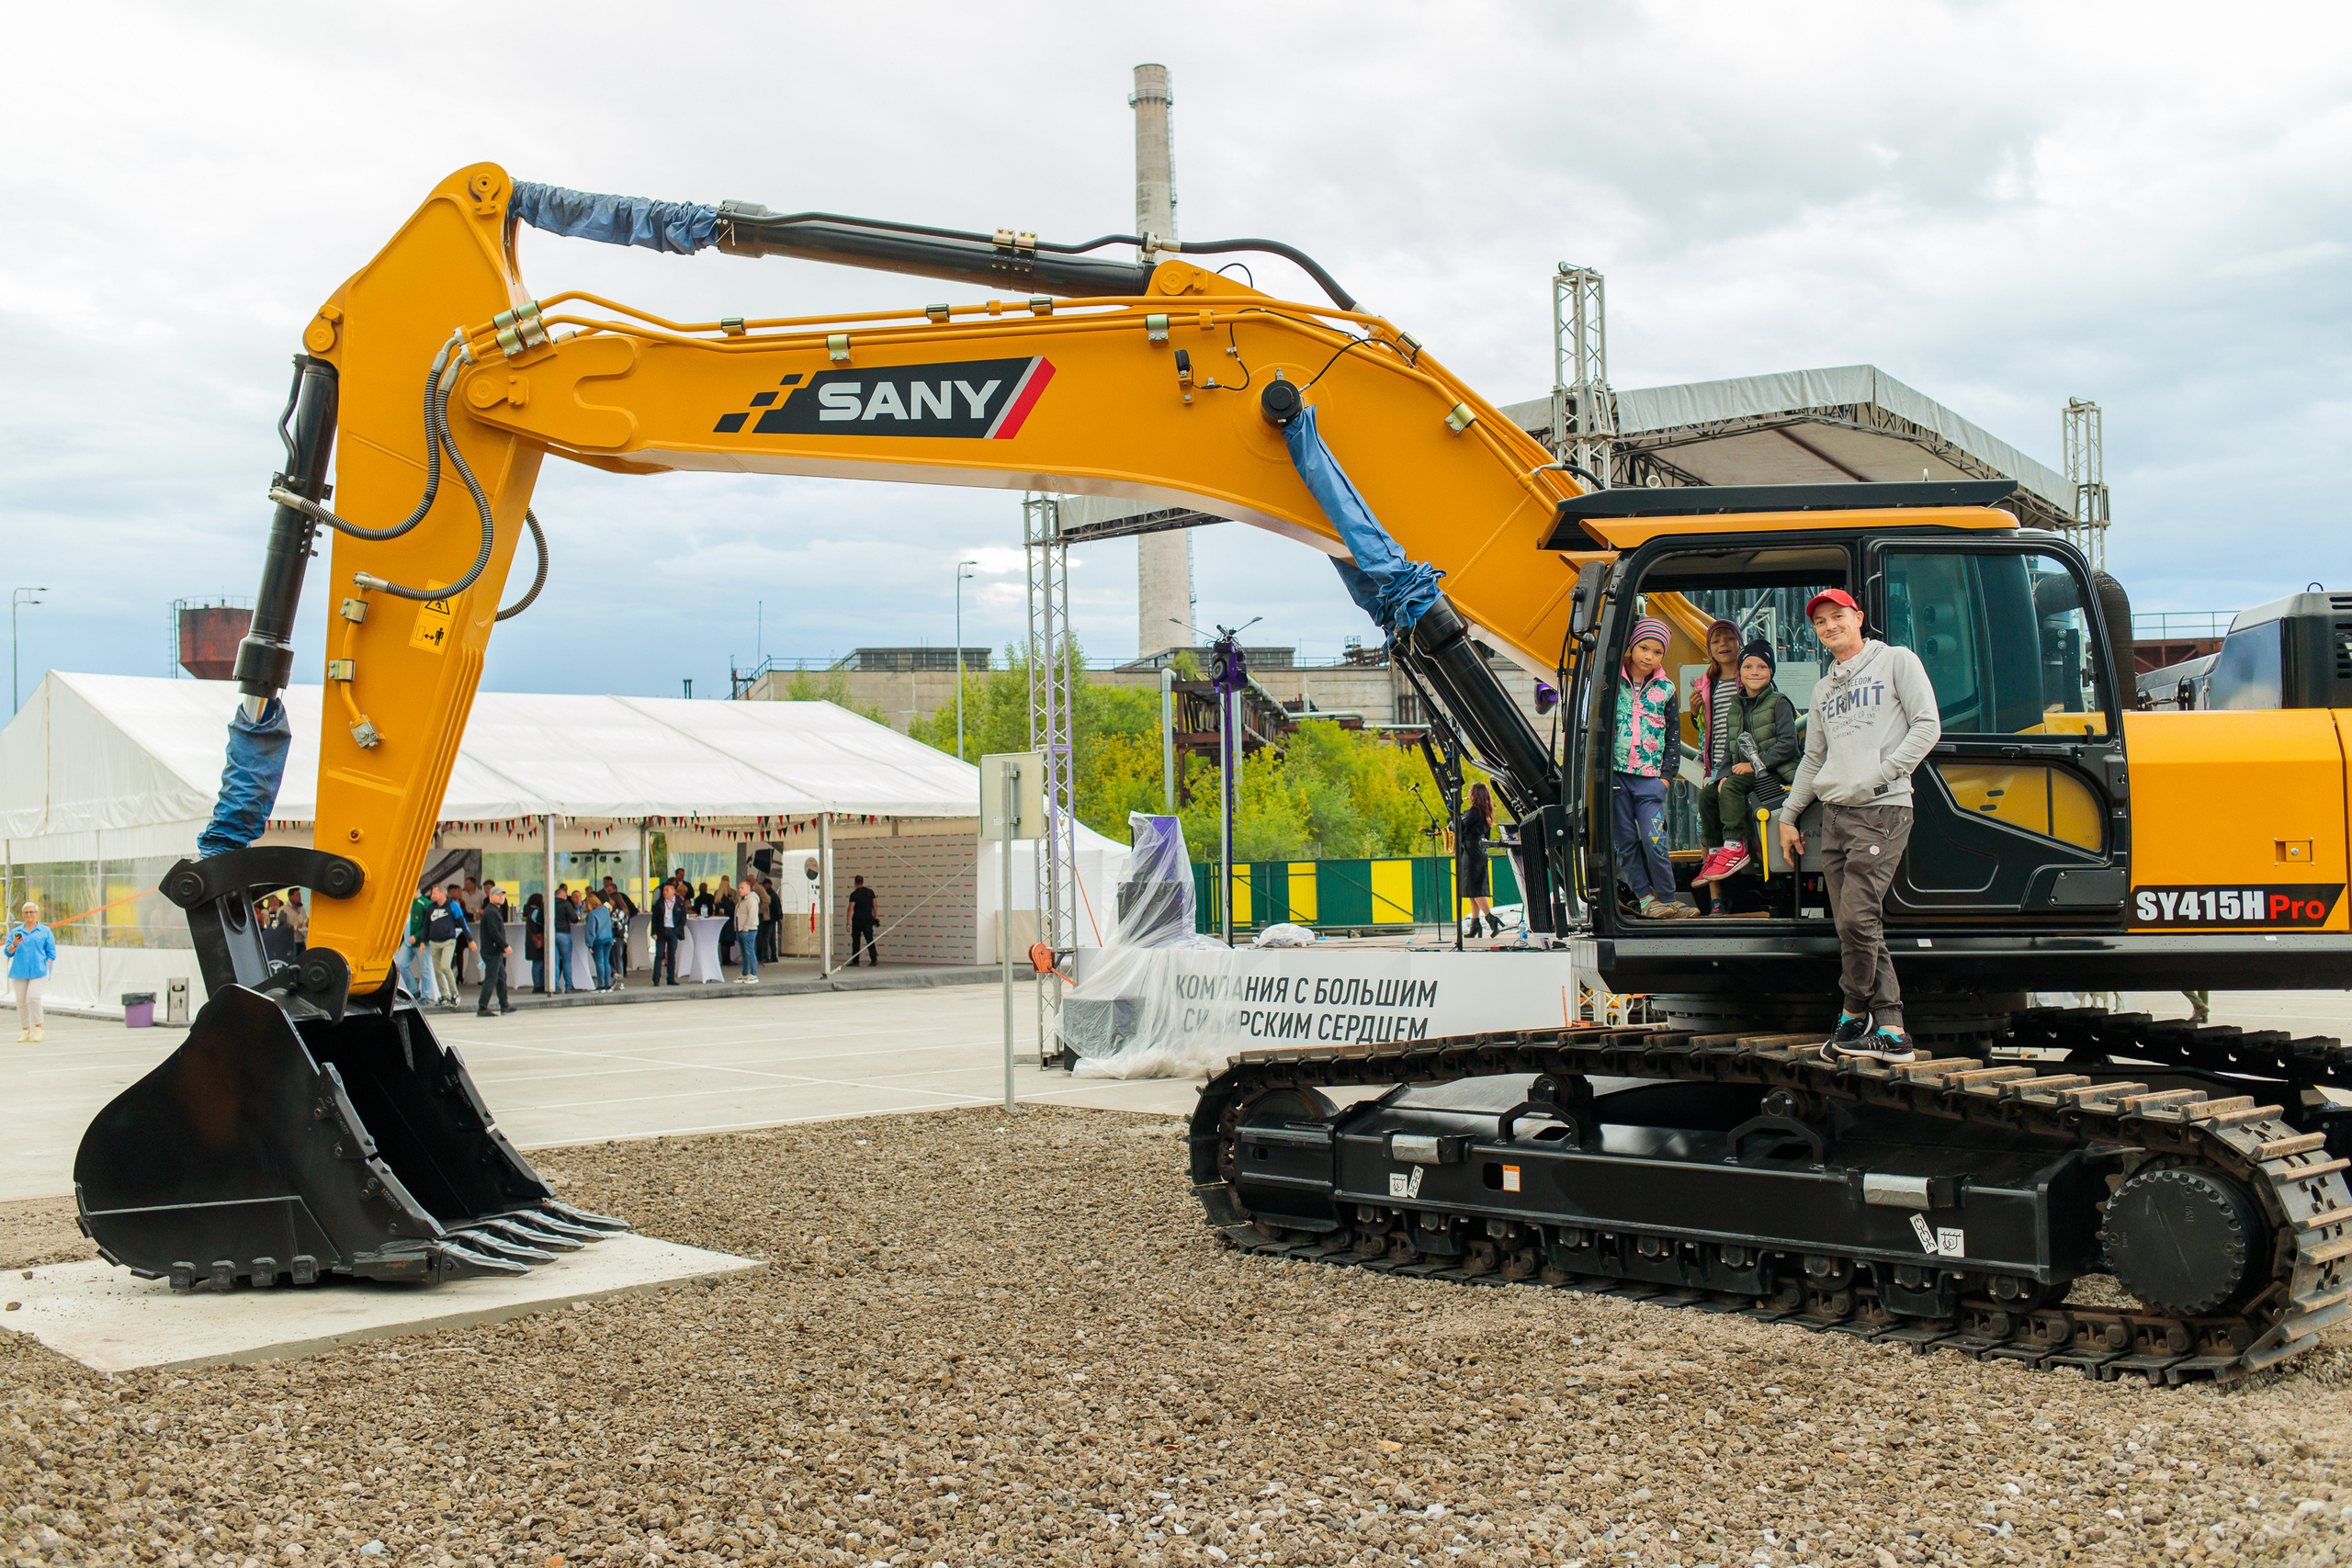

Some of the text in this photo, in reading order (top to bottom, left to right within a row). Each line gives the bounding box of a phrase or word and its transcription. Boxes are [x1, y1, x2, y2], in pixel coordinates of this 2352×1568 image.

[818, 379, 1001, 421] SANY
[1847, 676, 1872, 688] REEDOM
[2136, 890, 2325, 920] SY415H Pro
[1295, 976, 1309, 1004] С
[1314, 977, 1438, 1008] БОЛЬШИМ
[1317, 1013, 1429, 1045] СЕРДЦЕМ
